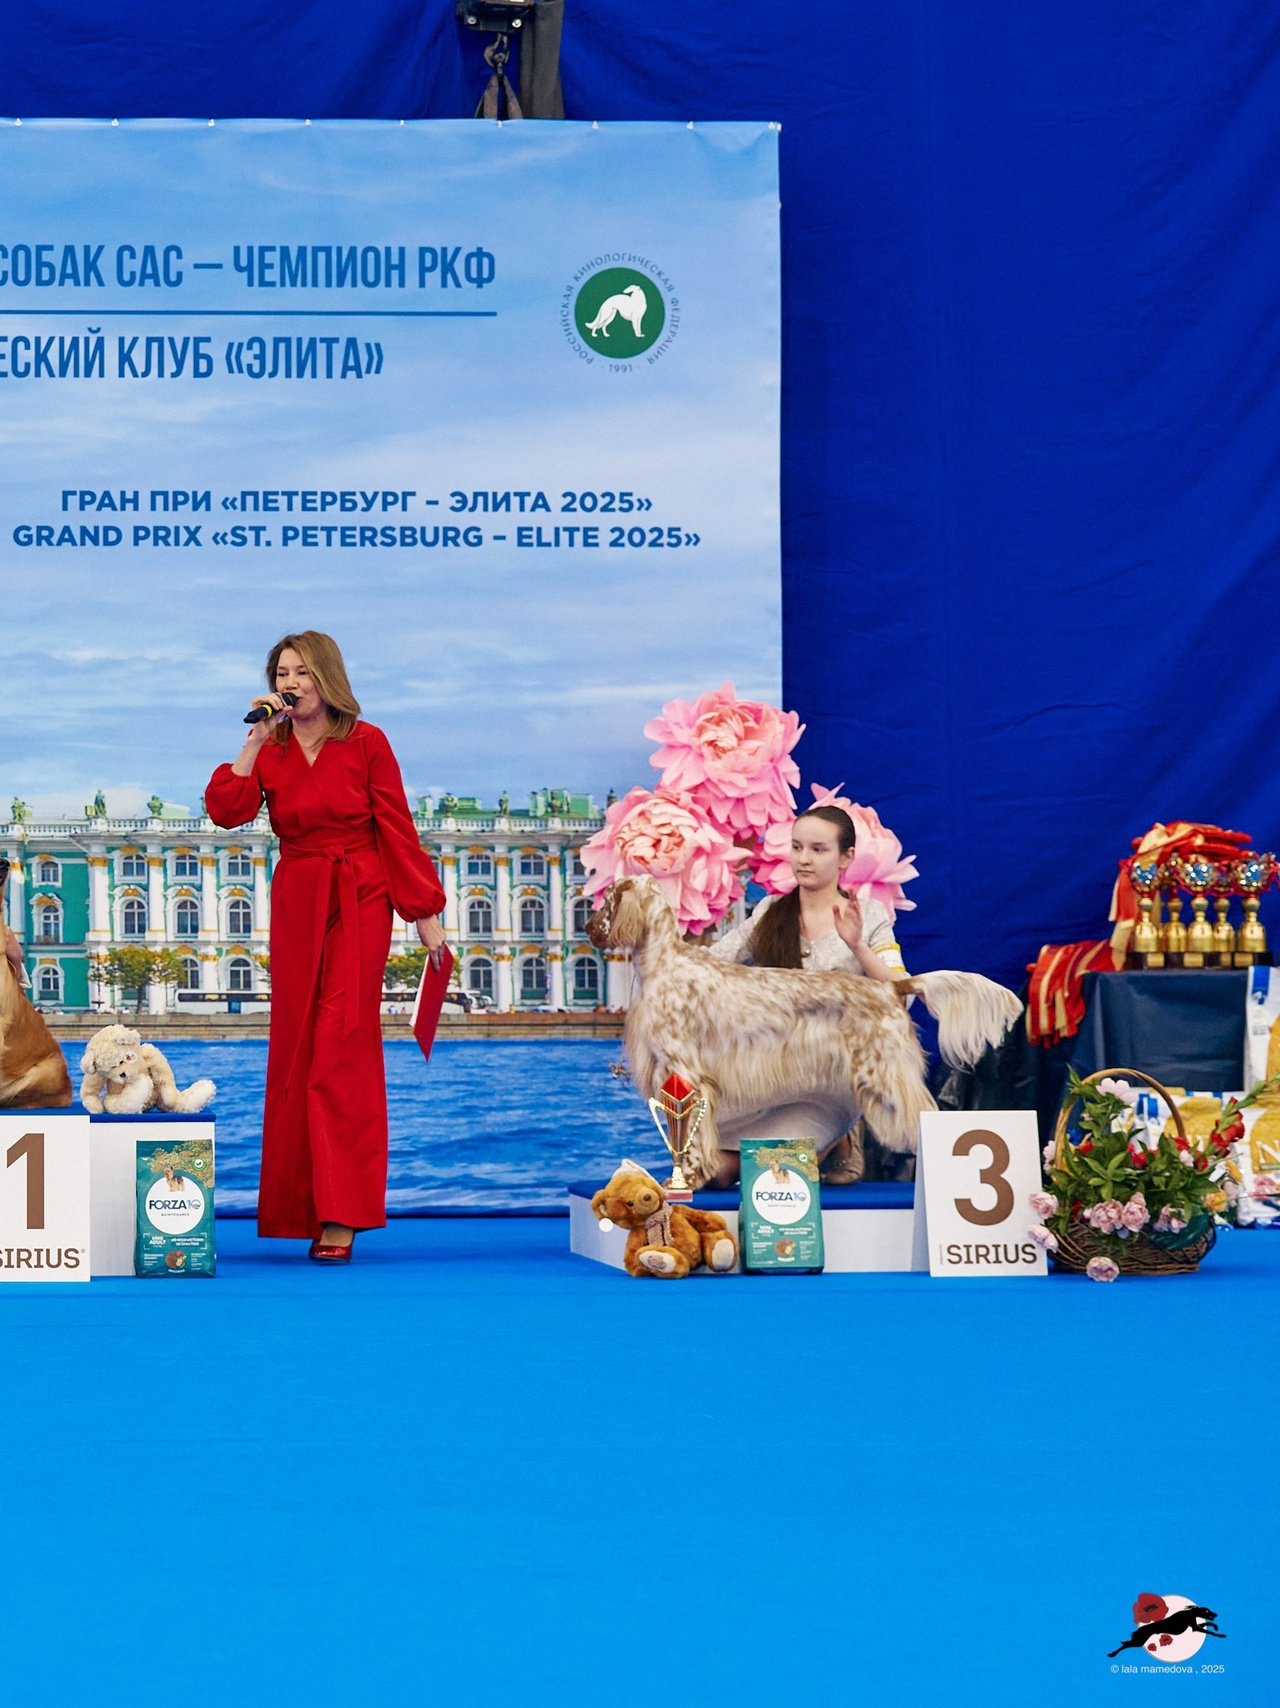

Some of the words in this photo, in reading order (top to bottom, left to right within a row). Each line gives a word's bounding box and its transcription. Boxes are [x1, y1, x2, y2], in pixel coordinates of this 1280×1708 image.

[232, 244, 407, 289] ЧЕМПИОН
[417, 245, 496, 290] РКФ
[572, 253, 675, 292] КИНОЛОГИЧЕСКАЯ
[560, 285, 595, 364] РОССИЙСКАЯ
[647, 297, 680, 365] ФЕДЕРАЦИЯ
[118, 336, 214, 379] КЛУБ
[225, 336, 384, 380] «ЭЛИТА»
[609, 364, 633, 373] 1991
[61, 490, 140, 512] ГРАН
[150, 490, 212, 512] ПРИ
[221, 490, 417, 513] «ПЕТЕРБУРГ
[449, 491, 552, 513] ЭЛИТА
[561, 491, 653, 513] 2025»
[12, 524, 123, 547] GRAND
[133, 525, 203, 547] PRIX
[211, 525, 272, 548] «ST.
[282, 525, 483, 548] PETERSBURG
[516, 526, 600, 548] ELITE
[609, 526, 701, 548] 2025»
[6, 1133, 45, 1229] 1
[952, 1129, 1014, 1226] 3
[947, 1243, 1037, 1265] SIRIUS
